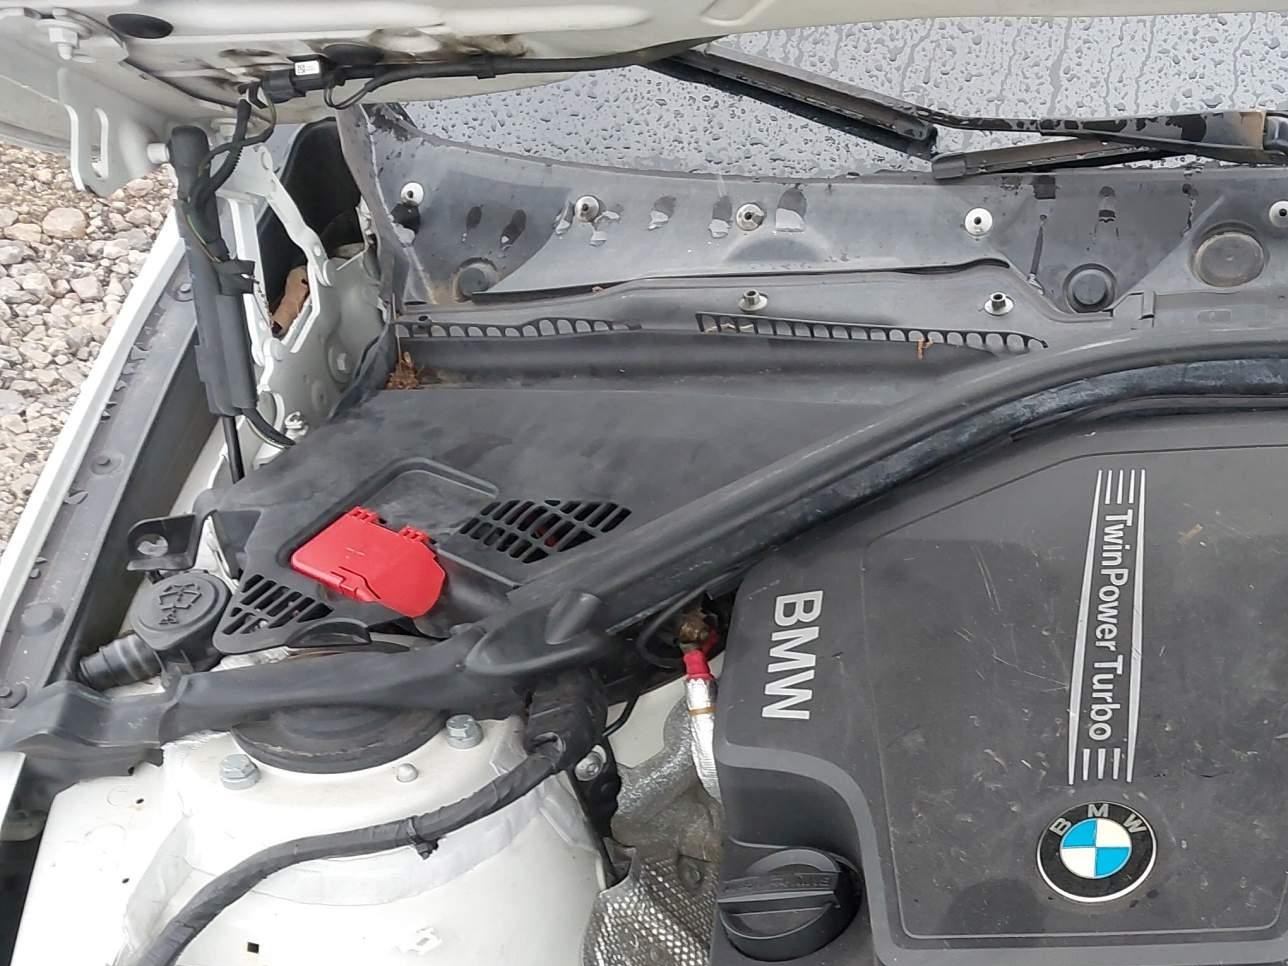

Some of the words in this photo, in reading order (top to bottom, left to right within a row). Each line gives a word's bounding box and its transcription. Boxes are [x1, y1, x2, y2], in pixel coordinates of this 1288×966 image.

[1094, 509, 1134, 652] TwinPower
[761, 590, 824, 720] BMW
[1088, 654, 1124, 741] Turbo
[1049, 803, 1147, 836] BMW
